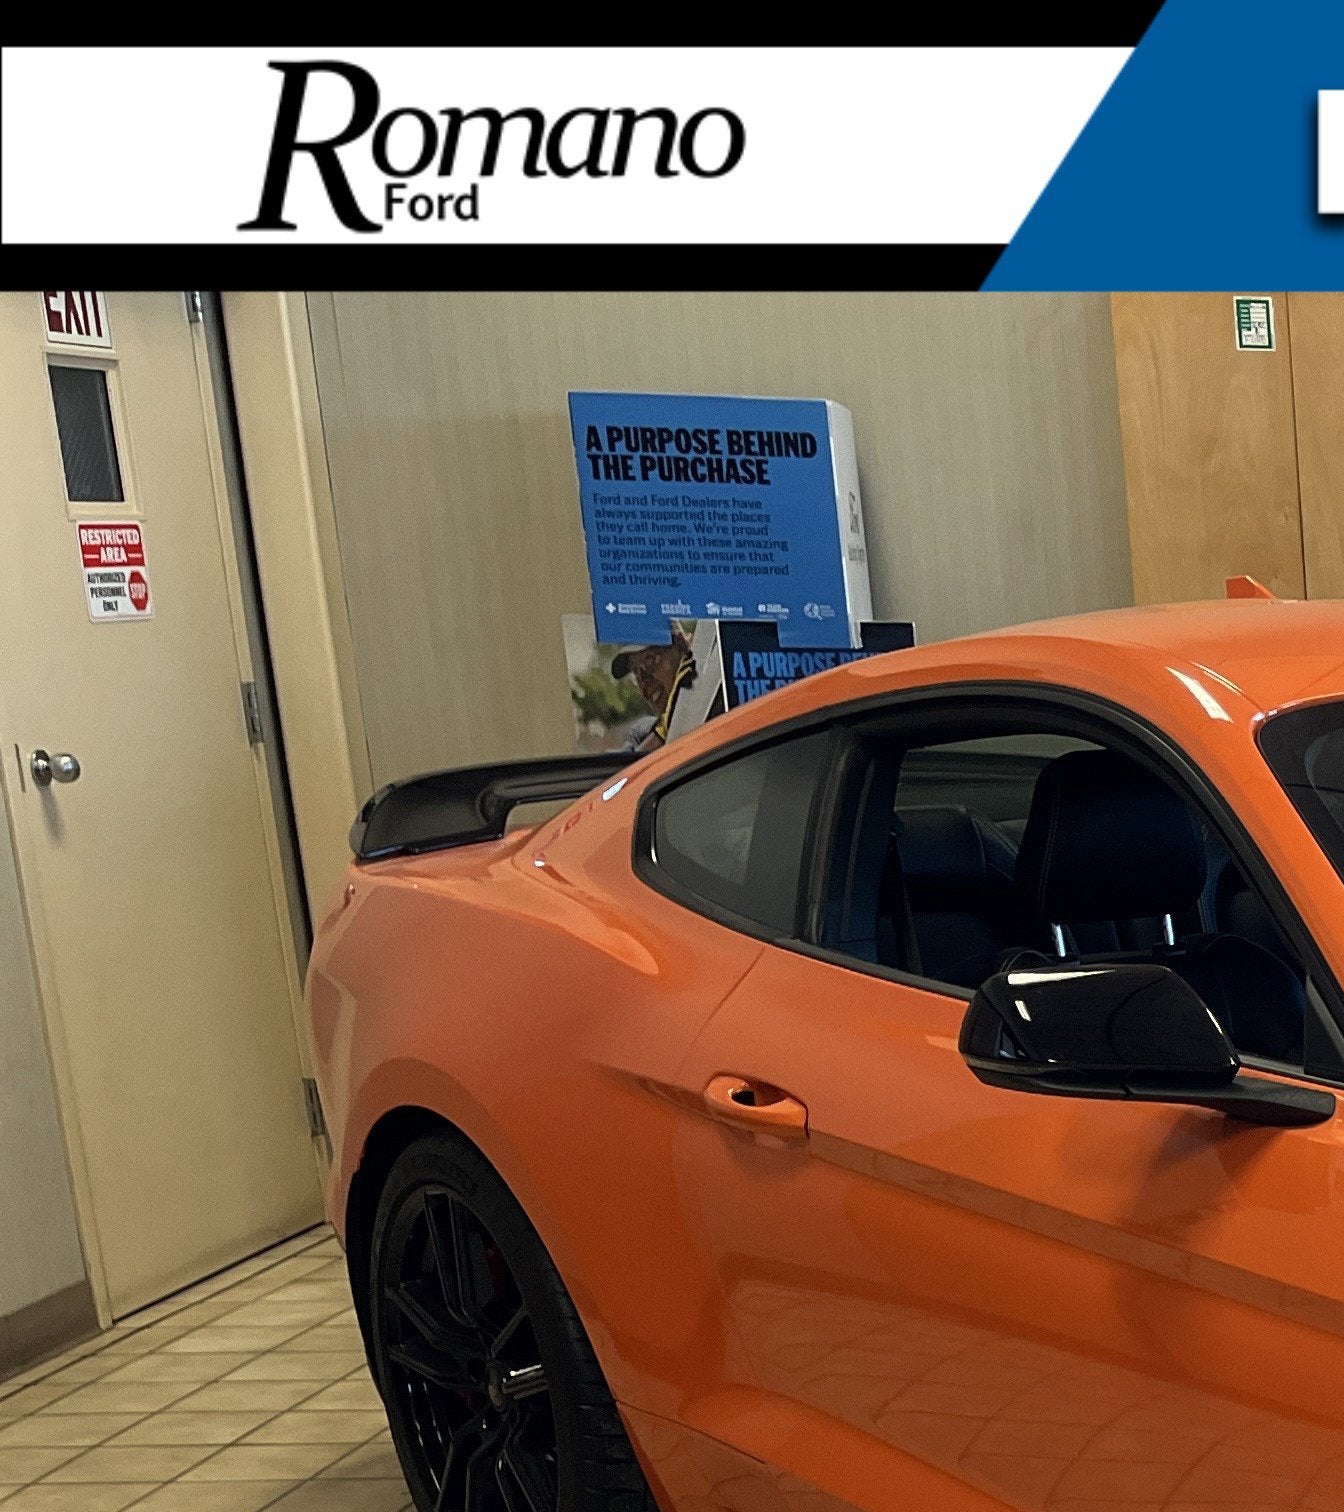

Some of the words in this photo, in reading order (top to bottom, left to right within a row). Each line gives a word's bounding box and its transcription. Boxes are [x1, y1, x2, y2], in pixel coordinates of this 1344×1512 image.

[586, 425, 603, 452] A
[606, 426, 723, 455] PURPOSE
[726, 429, 817, 459] BEHIND
[587, 453, 636, 482] THE
[639, 455, 772, 486] PURCHASE
[593, 493, 621, 506] Ford
[624, 495, 647, 506] and
[651, 495, 679, 507] Ford
[682, 496, 730, 508] Dealers
[733, 498, 762, 509] have
[595, 509, 637, 521] always
[640, 510, 705, 522] supported
[707, 511, 728, 522] the
[731, 512, 771, 523] places
[80, 528, 140, 545] RESTRICTED
[596, 521, 624, 534] they
[627, 522, 648, 532] call
[651, 523, 690, 533] home.
[693, 523, 728, 535] We're
[732, 525, 769, 537] proud
[598, 535, 611, 545] to
[614, 536, 646, 546] team
[649, 537, 666, 549] up
[668, 536, 695, 547] with
[698, 537, 732, 548] these
[735, 539, 789, 551] amazing
[100, 546, 127, 563] AREA
[600, 548, 685, 560] organizations
[688, 549, 700, 560] to
[704, 551, 746, 562] ensure
[748, 551, 775, 562] that
[601, 562, 623, 572] our
[625, 562, 707, 574] communities
[710, 564, 730, 574] are
[733, 565, 789, 577] prepared
[602, 575, 626, 586] and
[629, 576, 681, 588] thriving.
[733, 651, 747, 678] A
